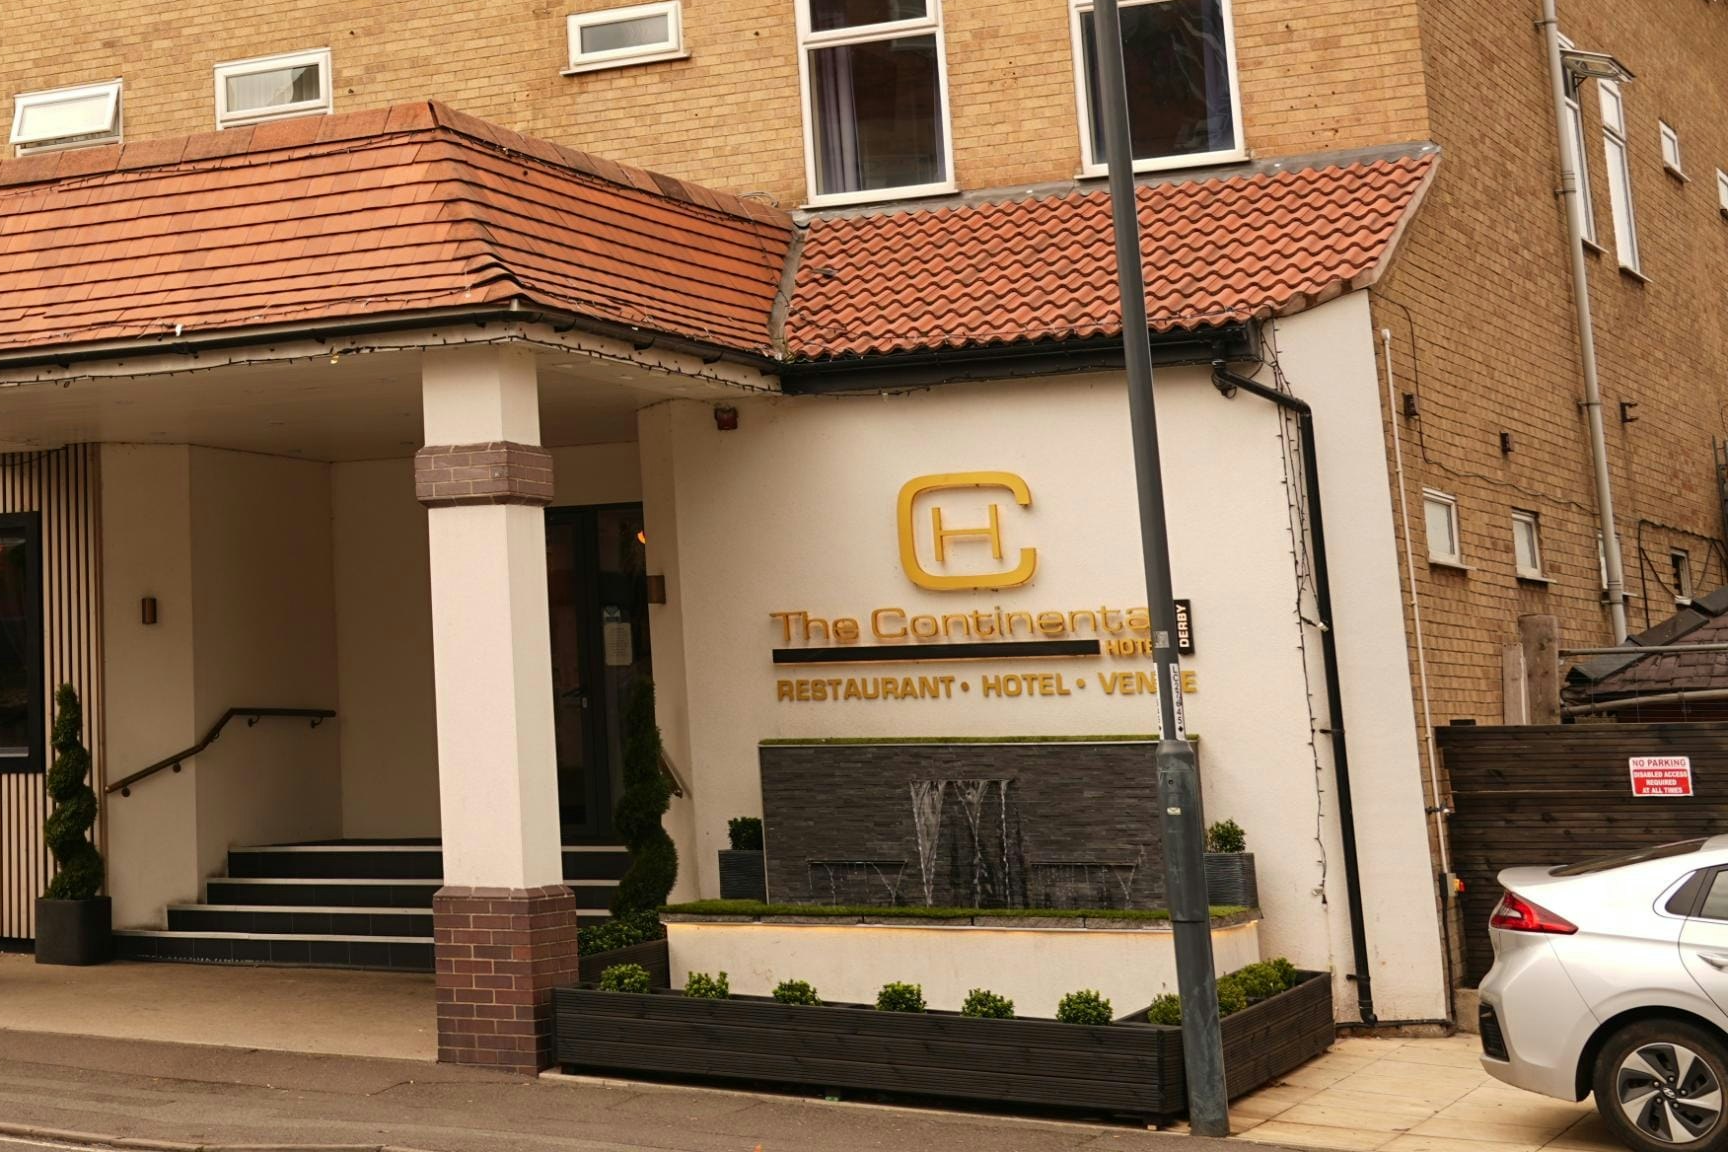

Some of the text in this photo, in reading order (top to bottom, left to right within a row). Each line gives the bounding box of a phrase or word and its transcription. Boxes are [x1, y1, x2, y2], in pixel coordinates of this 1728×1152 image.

[770, 604, 1151, 643] The Continenta
[1176, 604, 1190, 648] DERBY
[1104, 638, 1153, 657] HOTE
[777, 670, 1198, 702] RESTAURANT HOTEL VENE
[1632, 759, 1686, 767] NO PARKING
